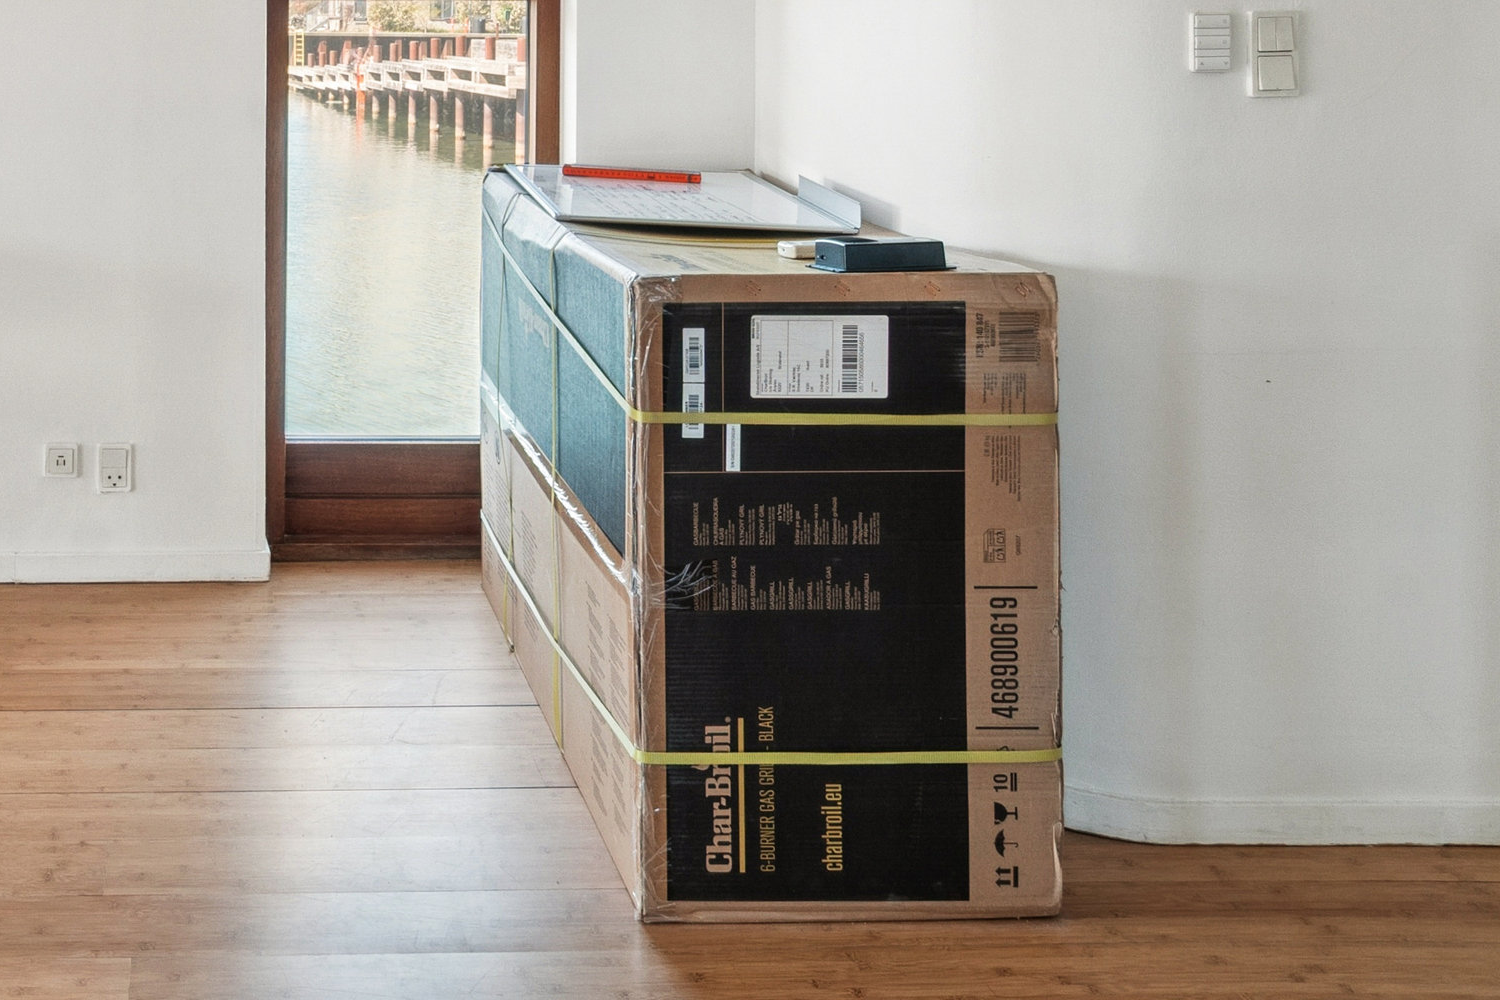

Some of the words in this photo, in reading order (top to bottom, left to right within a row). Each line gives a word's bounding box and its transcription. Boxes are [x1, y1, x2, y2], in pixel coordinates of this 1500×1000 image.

[989, 597, 1019, 719] 468900619
[758, 706, 774, 742] BLACK
[759, 789, 775, 812] GAS
[993, 773, 1008, 793] 10
[759, 816, 775, 872] 6-BURNER
[820, 783, 843, 872] charbroil.eu
